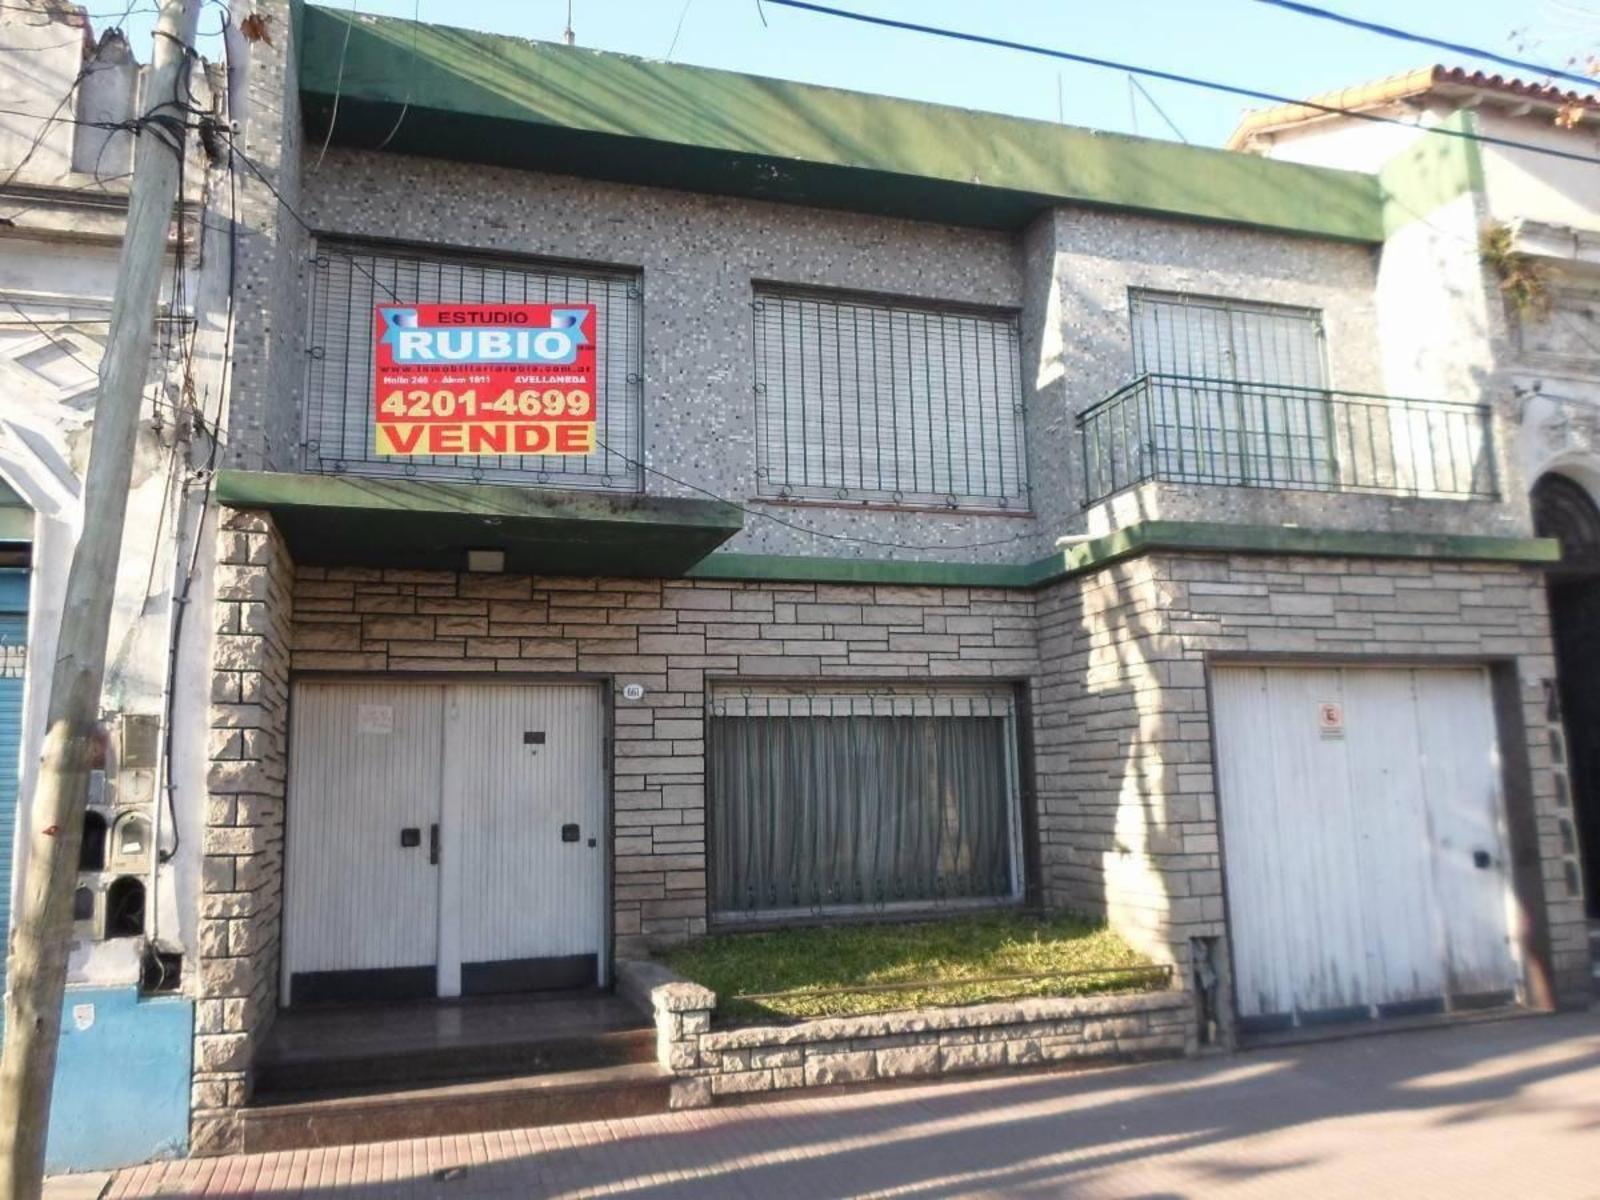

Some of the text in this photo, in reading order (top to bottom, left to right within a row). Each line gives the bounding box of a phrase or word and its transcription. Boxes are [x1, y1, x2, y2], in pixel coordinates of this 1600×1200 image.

[438, 311, 528, 324] ESTUDIO
[399, 330, 571, 360] RUBIO
[514, 375, 587, 384] AVELLANEDA
[380, 389, 591, 417] 4201-4699
[382, 424, 590, 453] VENDE
